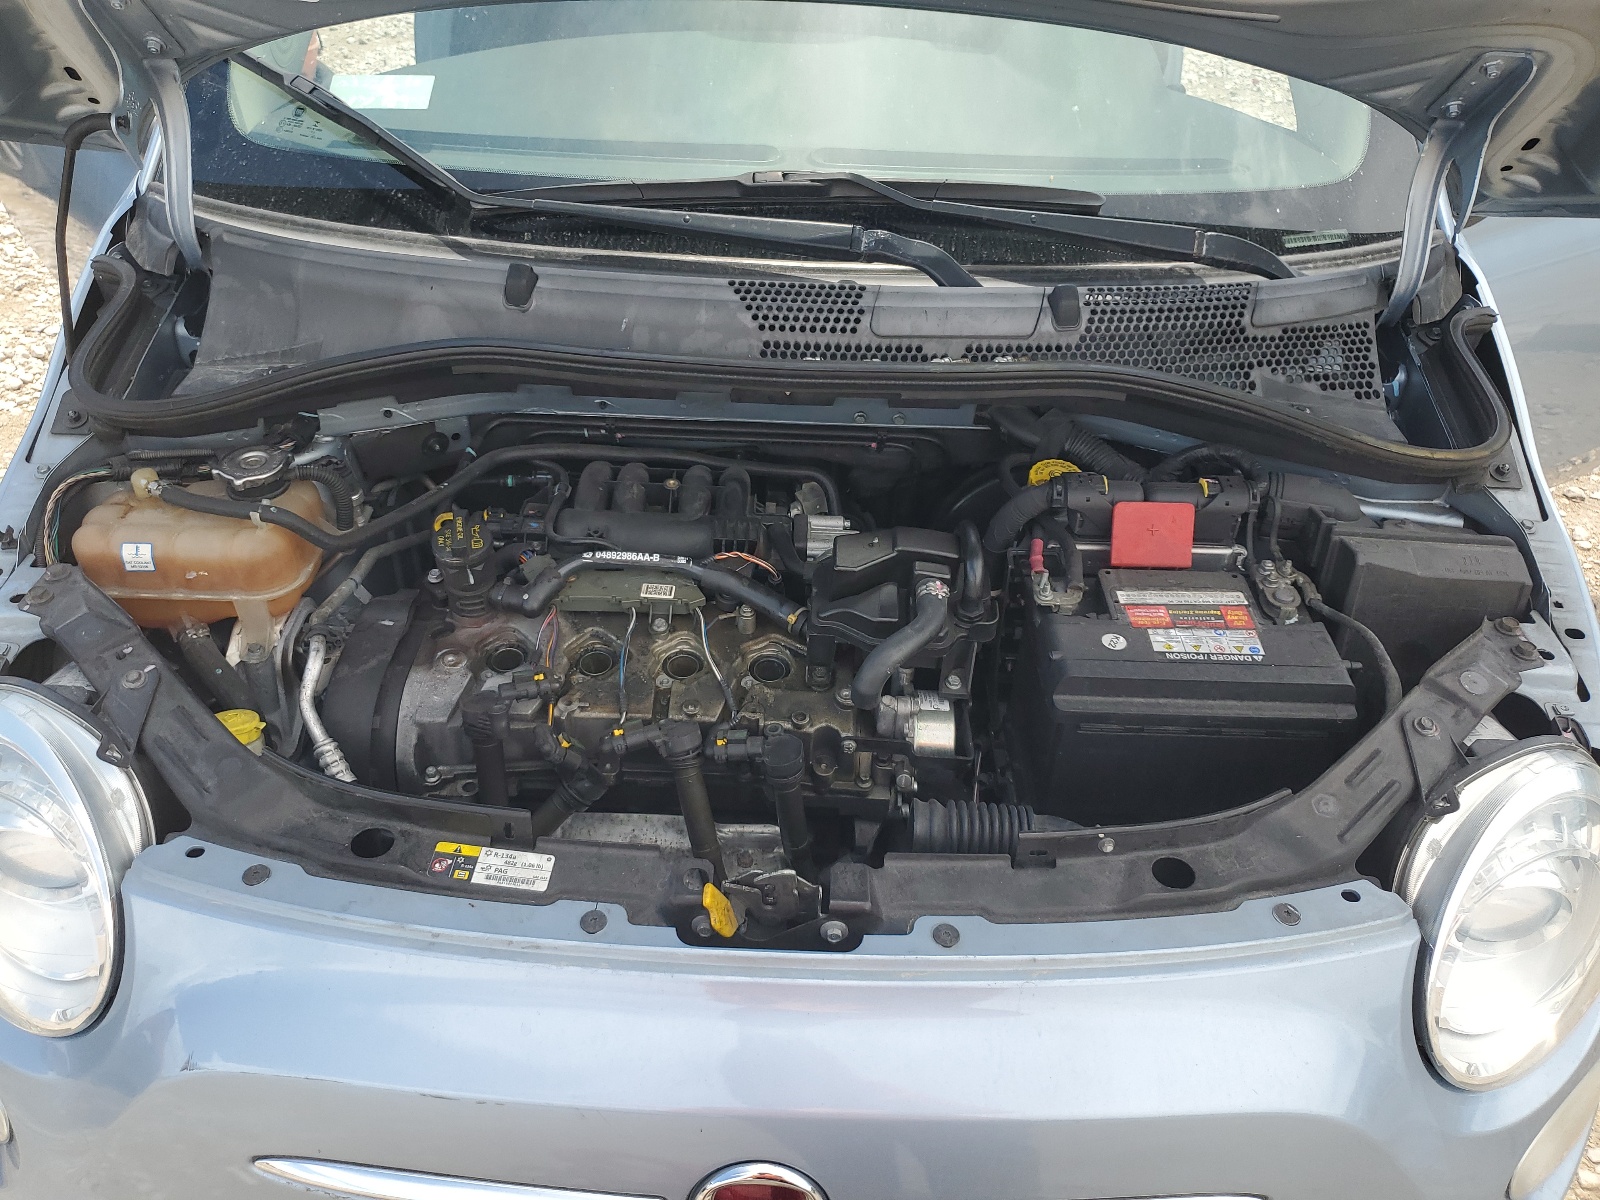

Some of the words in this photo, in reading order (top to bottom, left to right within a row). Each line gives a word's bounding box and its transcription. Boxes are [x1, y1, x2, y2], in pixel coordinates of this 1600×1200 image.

[595, 551, 660, 562] 04892986AA-B
[1165, 652, 1204, 660] POISON
[1209, 653, 1253, 661] DANGER
[493, 867, 509, 875] PAG
